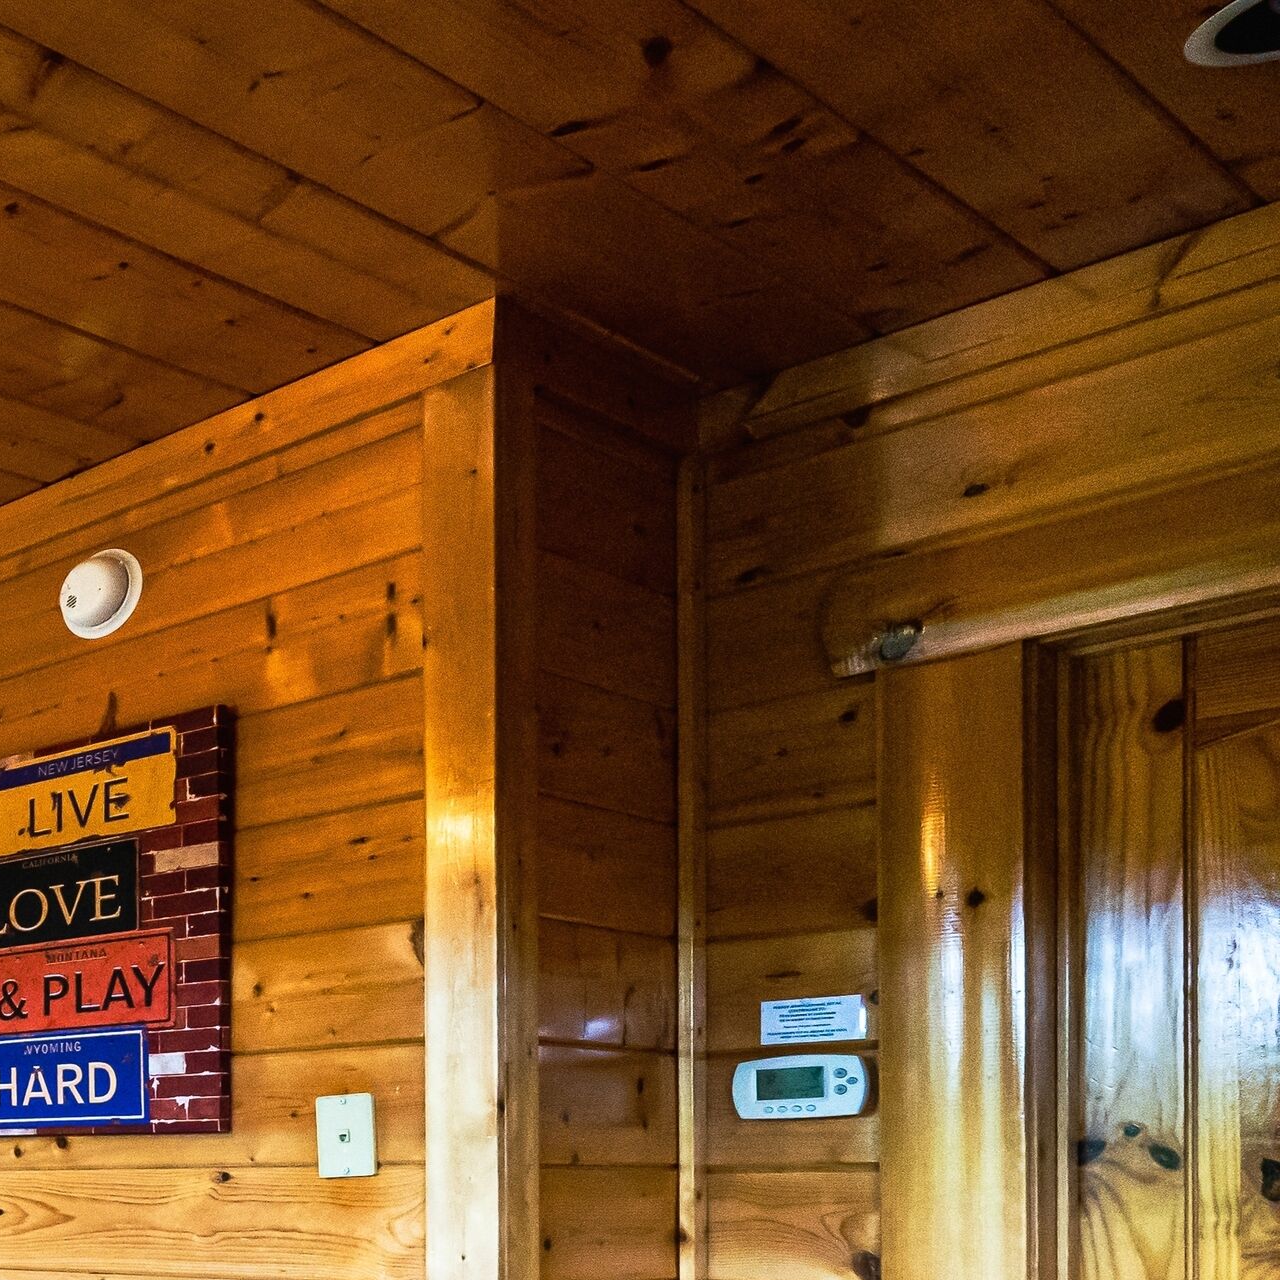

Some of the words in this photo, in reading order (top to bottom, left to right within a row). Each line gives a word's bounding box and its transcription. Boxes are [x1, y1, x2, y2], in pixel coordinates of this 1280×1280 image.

[38, 762, 70, 777] NEW
[71, 749, 120, 770] JERSEY
[28, 777, 130, 838] LIVE
[21, 853, 80, 870] CALIFORNIA
[45, 949, 107, 965] MONTANA
[43, 961, 166, 1016] PLAY
[23, 1041, 82, 1056] WYOMING
